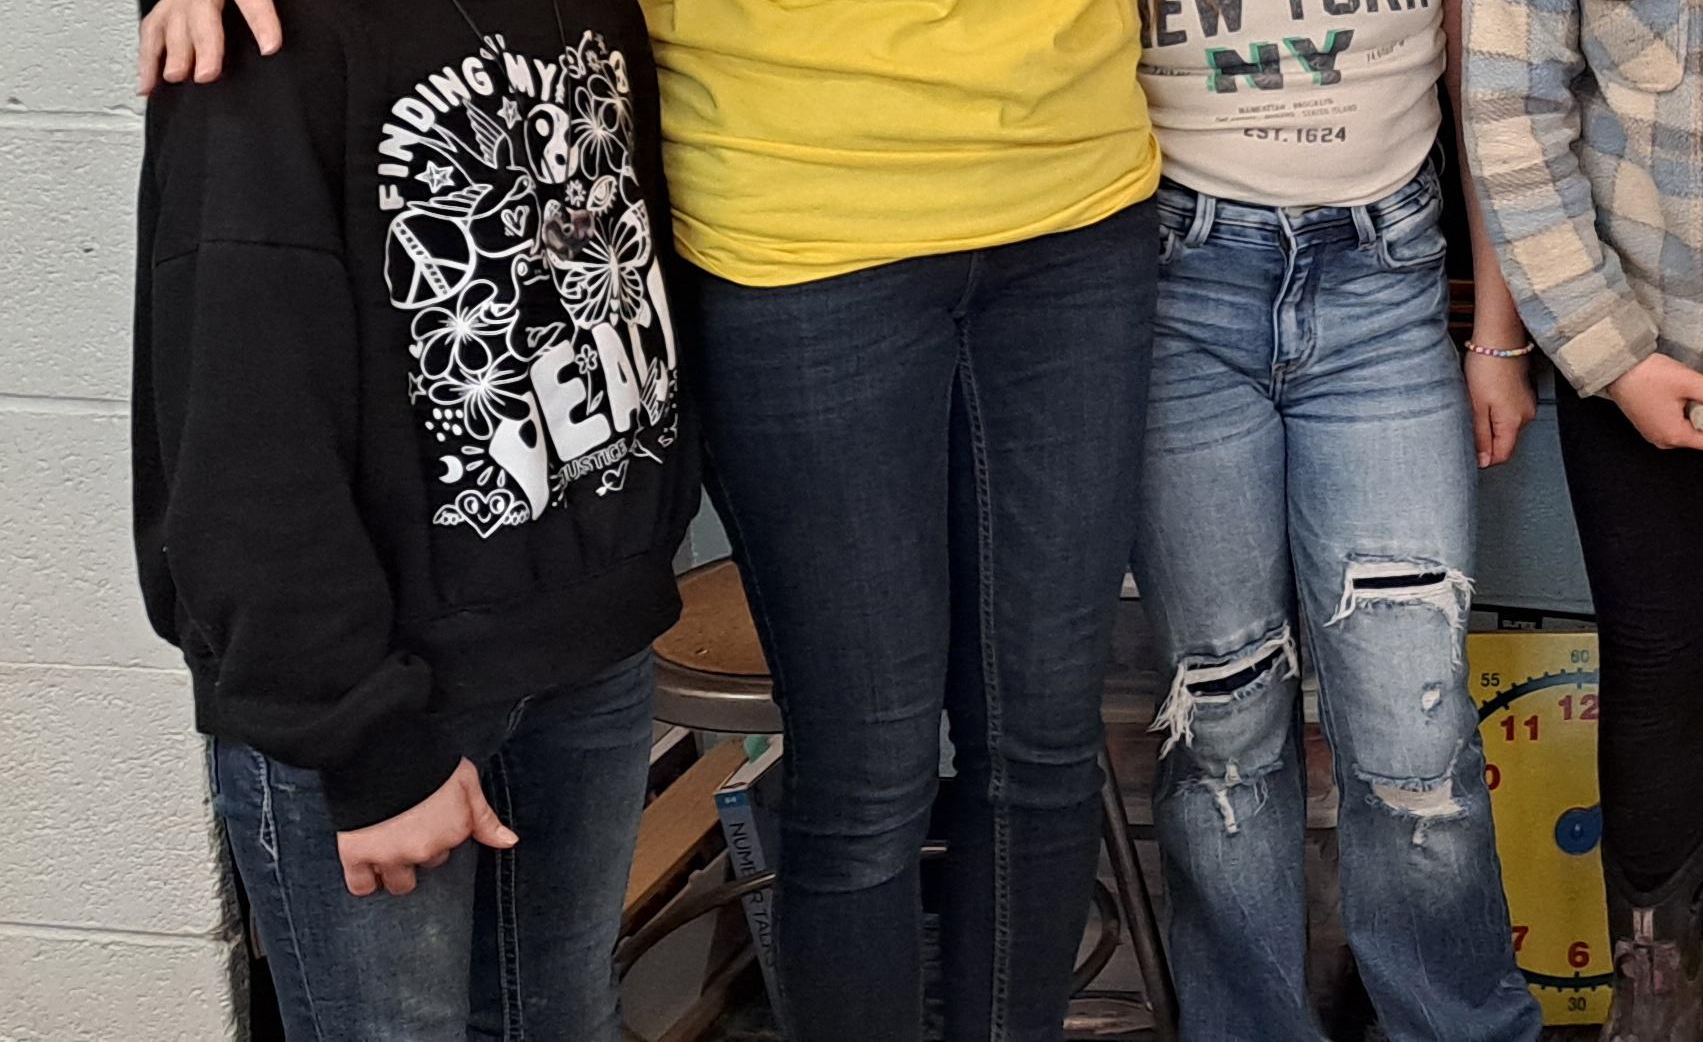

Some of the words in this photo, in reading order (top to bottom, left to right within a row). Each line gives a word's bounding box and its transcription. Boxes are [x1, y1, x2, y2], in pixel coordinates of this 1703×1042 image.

[1205, 28, 1354, 93] NY
[378, 57, 494, 211] FINDING
[502, 52, 557, 102] MY
[1296, 126, 1346, 143] 1624
[556, 437, 628, 482] JUSTICE
[1571, 649, 1590, 663] 60
[1480, 673, 1500, 687] 55
[1558, 695, 1599, 720] 12
[1500, 715, 1540, 741] 11
[1567, 941, 1591, 968] 6
[1568, 997, 1587, 1011] 30
